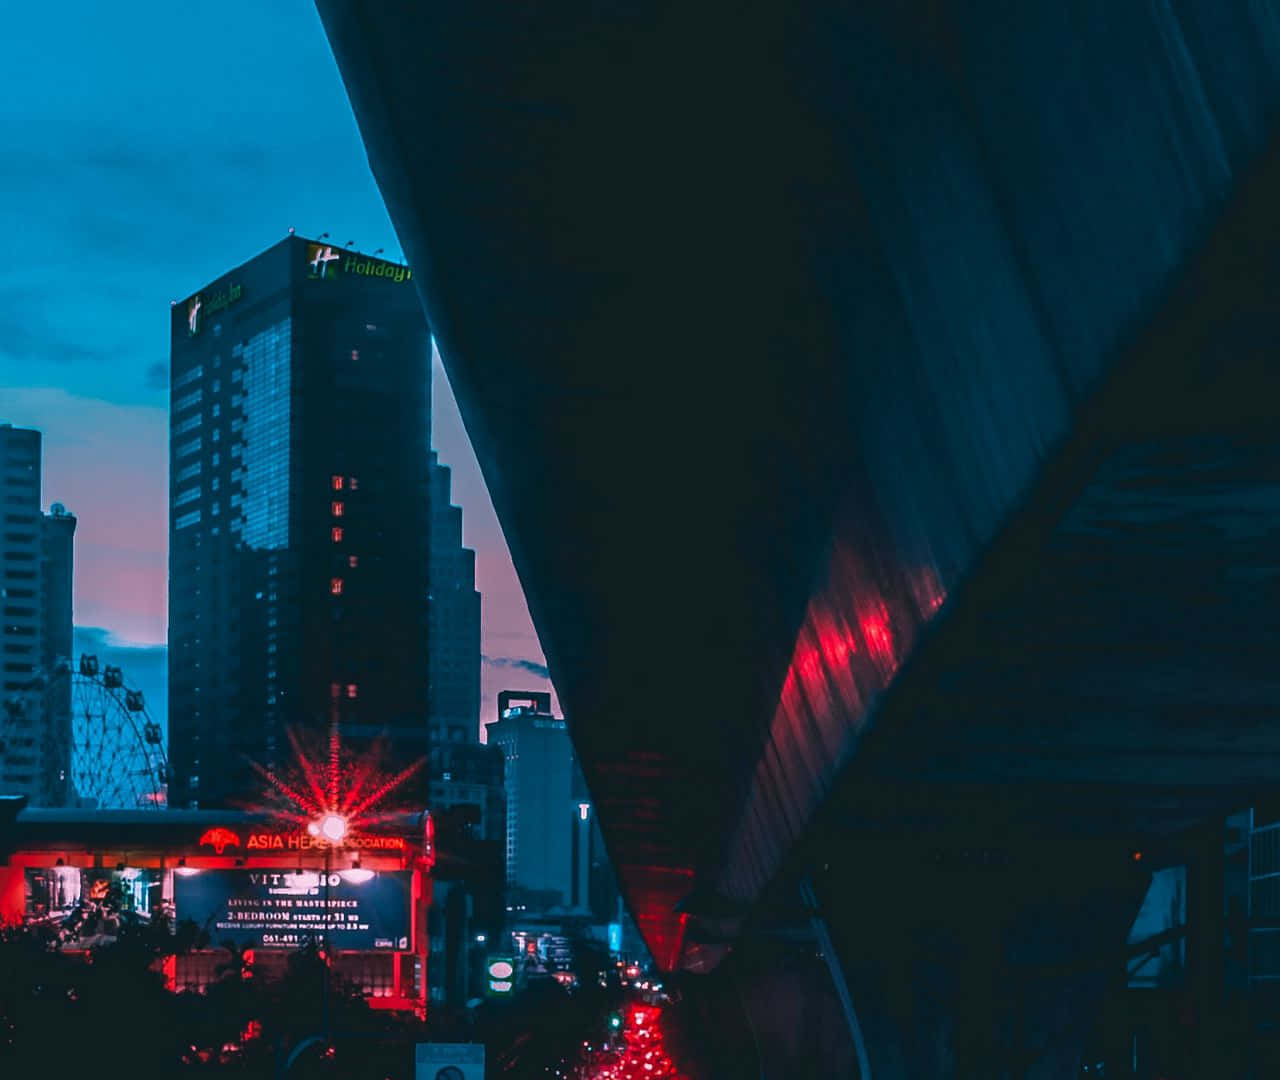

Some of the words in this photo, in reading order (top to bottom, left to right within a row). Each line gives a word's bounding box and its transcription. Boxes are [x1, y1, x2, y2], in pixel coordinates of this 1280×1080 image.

[344, 255, 405, 283] Holiday
[247, 834, 283, 849] ASIA
[227, 911, 290, 921] 2-BEDROOM
